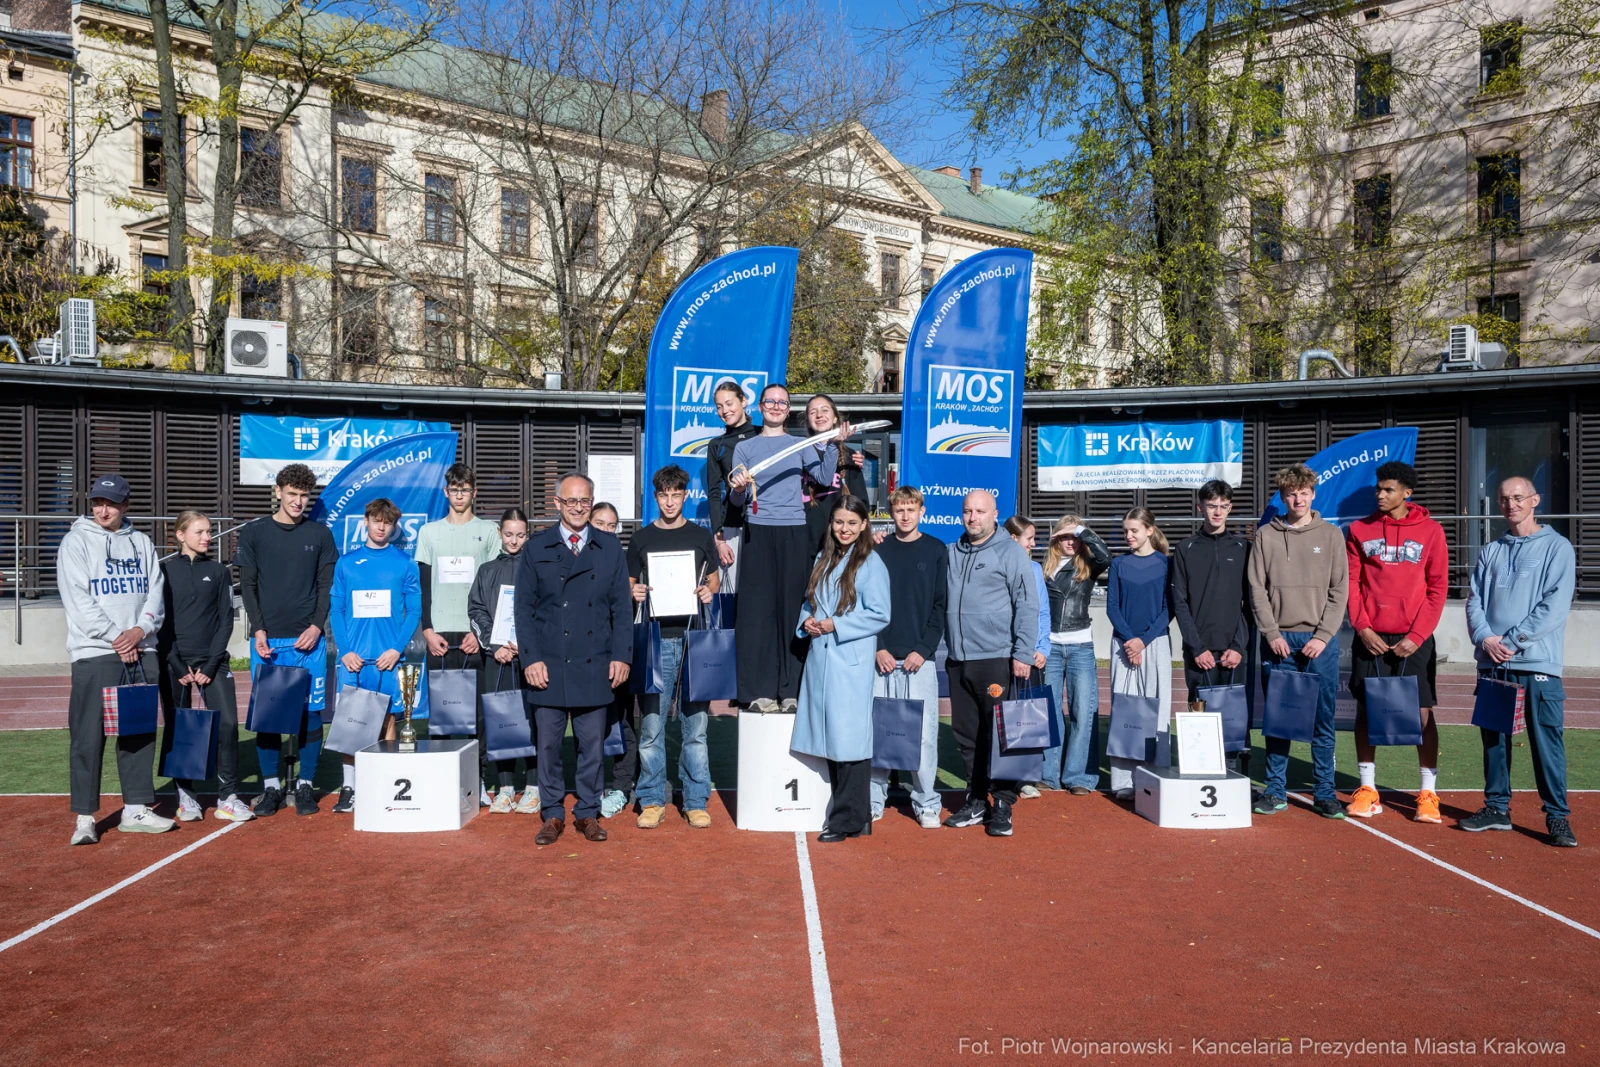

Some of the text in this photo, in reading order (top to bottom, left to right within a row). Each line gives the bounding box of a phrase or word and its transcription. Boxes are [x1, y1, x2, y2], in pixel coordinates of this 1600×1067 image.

[669, 263, 776, 350] www.mos-zachod.pl
[924, 264, 1015, 348] www.mos-zachod.pl
[936, 372, 1004, 404] MOS
[680, 405, 714, 413] KRAKÓW
[935, 402, 967, 411] KRAKÓW
[328, 429, 399, 449] Krakó
[1117, 432, 1194, 452] Kraków
[1317, 445, 1388, 485] zachod.pl
[326, 447, 432, 528] ww.mos-zachod.pl
[105, 558, 143, 575] STICK
[91, 577, 148, 597] TOGETHE
[393, 778, 412, 801] 2
[785, 778, 798, 801] 1
[1200, 785, 1218, 808] 3
